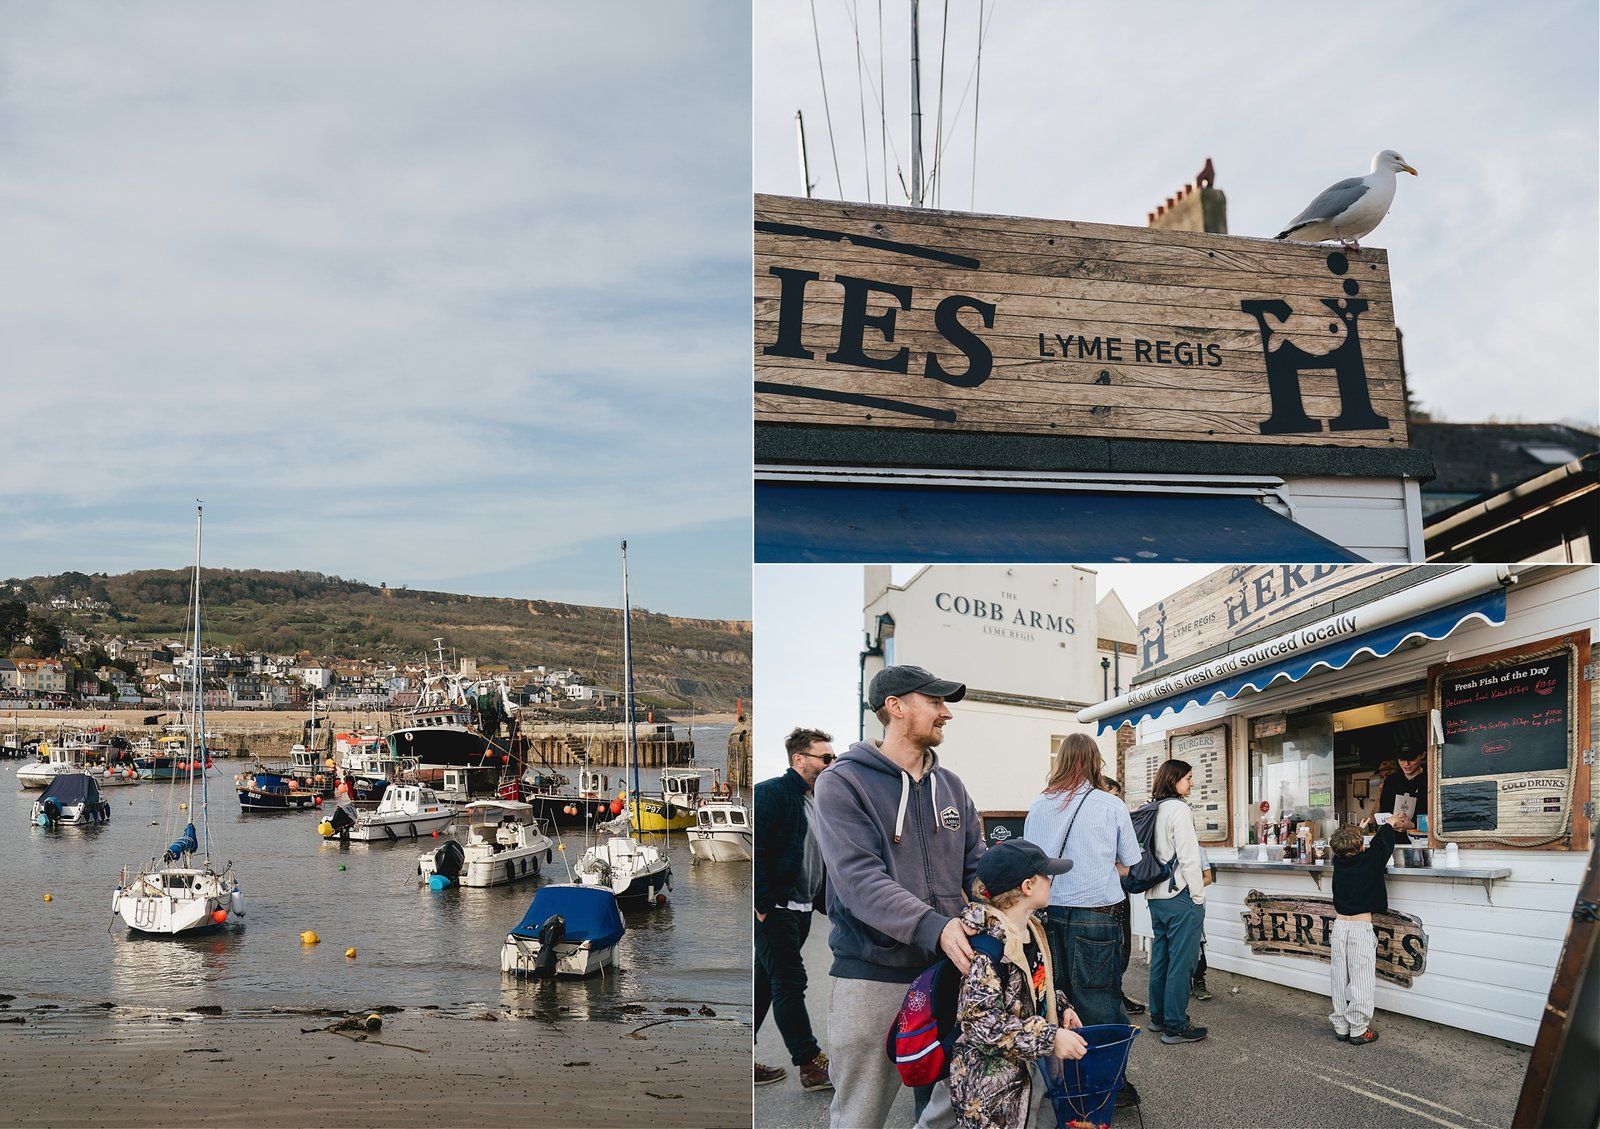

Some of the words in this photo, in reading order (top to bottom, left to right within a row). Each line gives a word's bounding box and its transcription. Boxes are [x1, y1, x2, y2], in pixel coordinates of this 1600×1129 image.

[1038, 332, 1123, 362] LYME
[1134, 337, 1223, 368] REGIS
[1000, 590, 1018, 601] THE
[935, 592, 1004, 621] COBB
[1012, 607, 1076, 636] ARMS
[1172, 621, 1193, 638] LYME
[1193, 611, 1217, 630] REGIS
[982, 625, 1007, 637] LYME
[1008, 629, 1035, 642] REGIS
[1127, 692, 1139, 706] All
[1138, 689, 1154, 702] our
[1154, 680, 1174, 697] fish
[1174, 678, 1184, 690] is
[1184, 667, 1214, 687] fresh
[1215, 657, 1239, 677] and
[1240, 635, 1299, 667] sourced
[1300, 614, 1358, 646] locally
[1454, 679, 1478, 692] Fresh
[1479, 674, 1499, 686] Fish
[1500, 672, 1511, 682] of
[1512, 670, 1528, 680] the
[1529, 665, 1550, 679] Day
[1178, 736, 1215, 753] BURGERS
[1502, 781, 1527, 791] COLD
[1527, 779, 1566, 788] DRINKS
[645, 804, 661, 813] P97
[698, 831, 715, 840] E27
[1243, 903, 1425, 972] HERES
